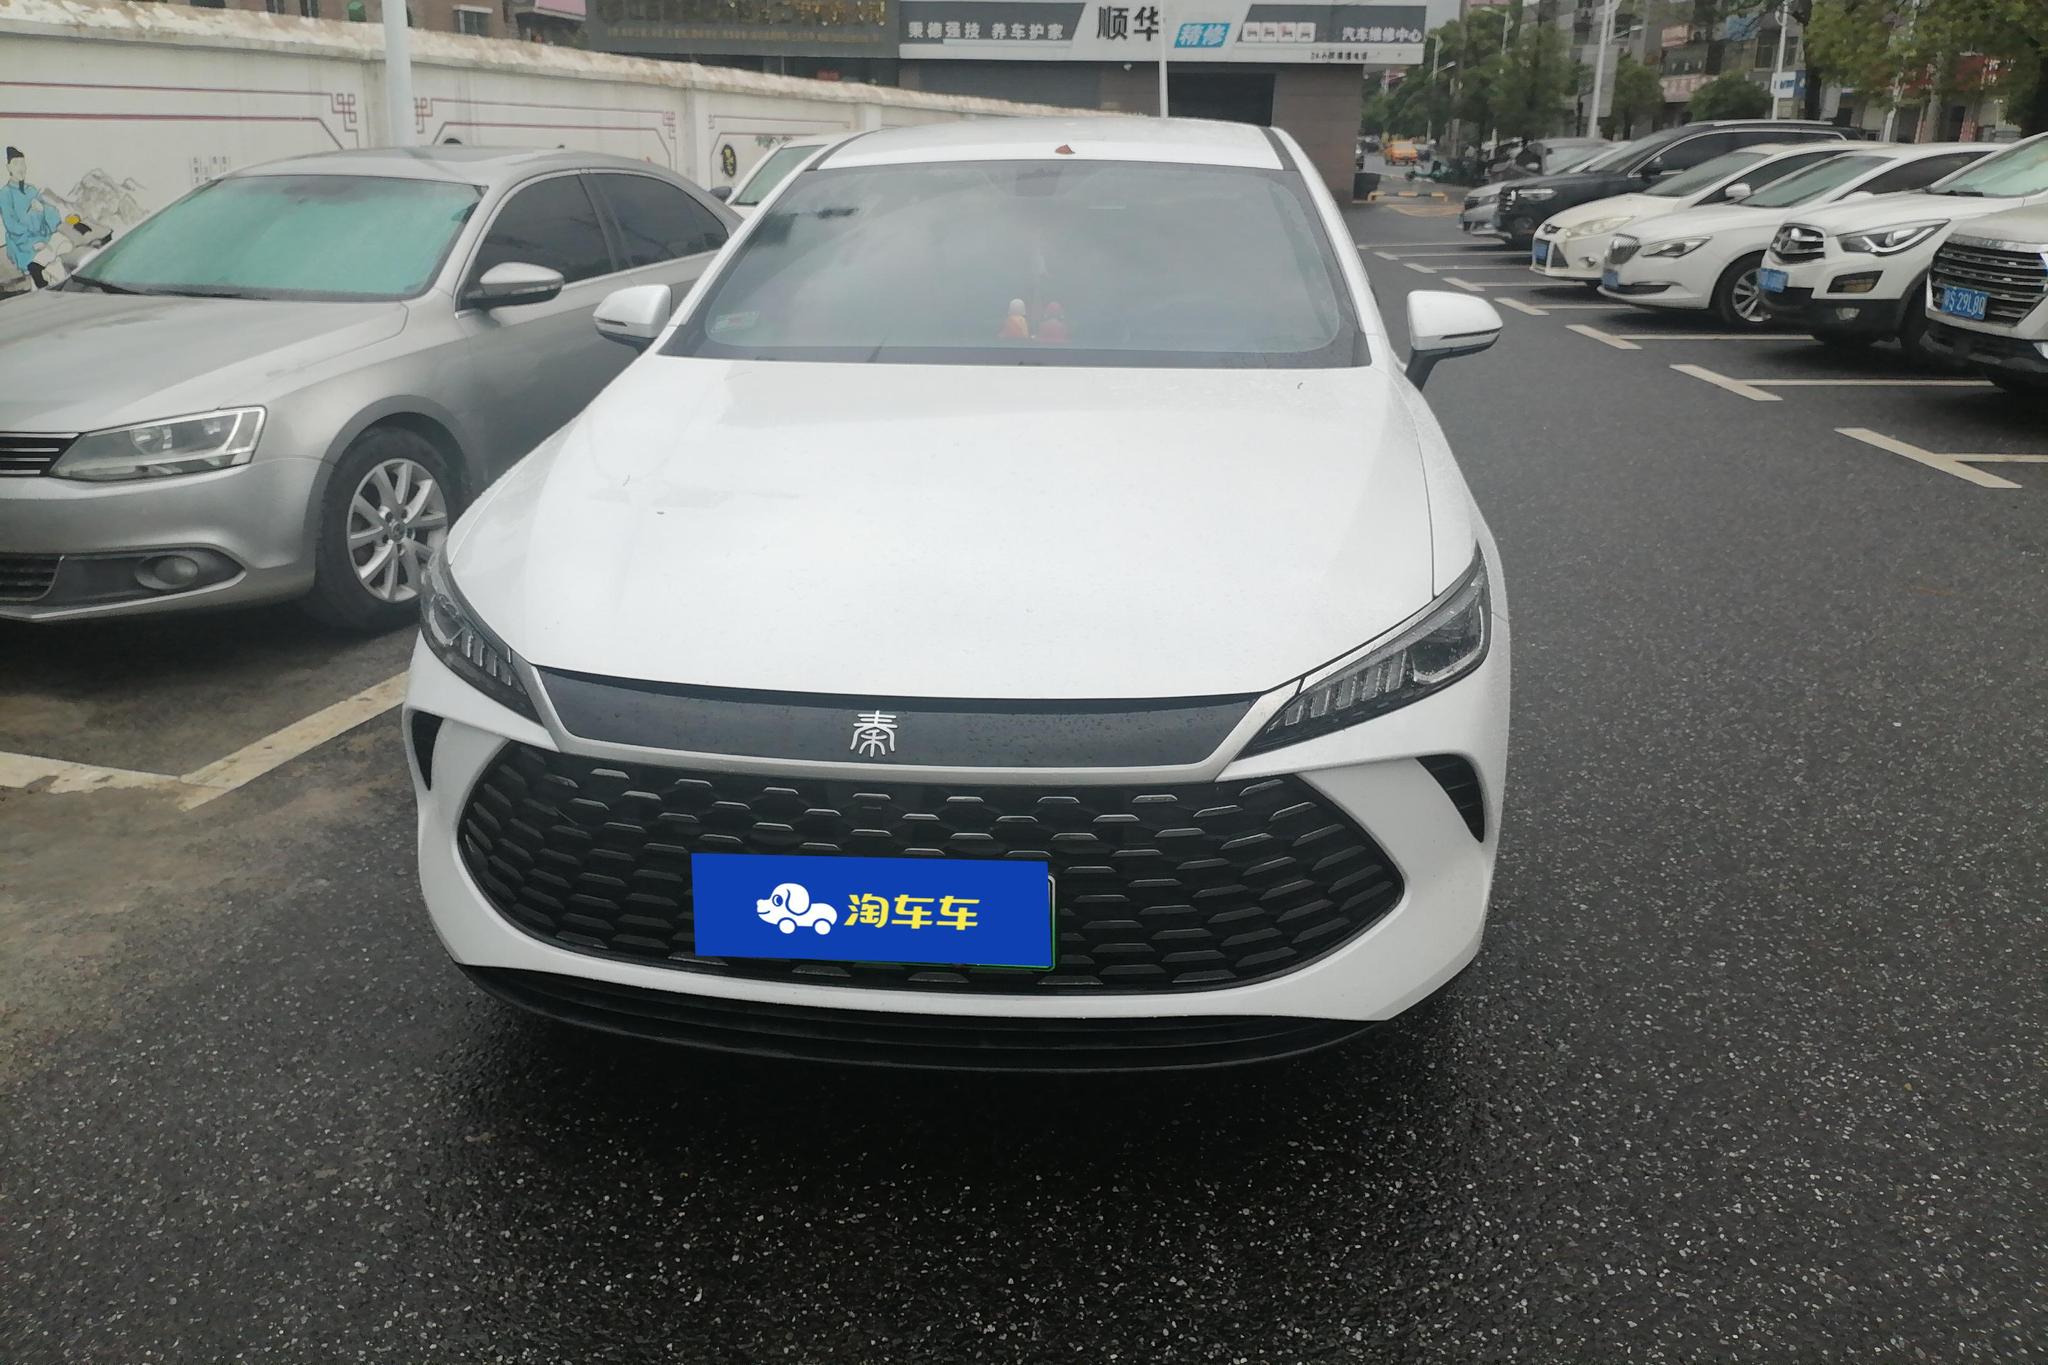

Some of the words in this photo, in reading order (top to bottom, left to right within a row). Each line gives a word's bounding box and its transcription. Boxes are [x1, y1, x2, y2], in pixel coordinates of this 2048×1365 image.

[1097, 6, 1159, 41] 顺华
[1342, 27, 1422, 42] 汽车维修中心
[850, 710, 898, 757] 秦
